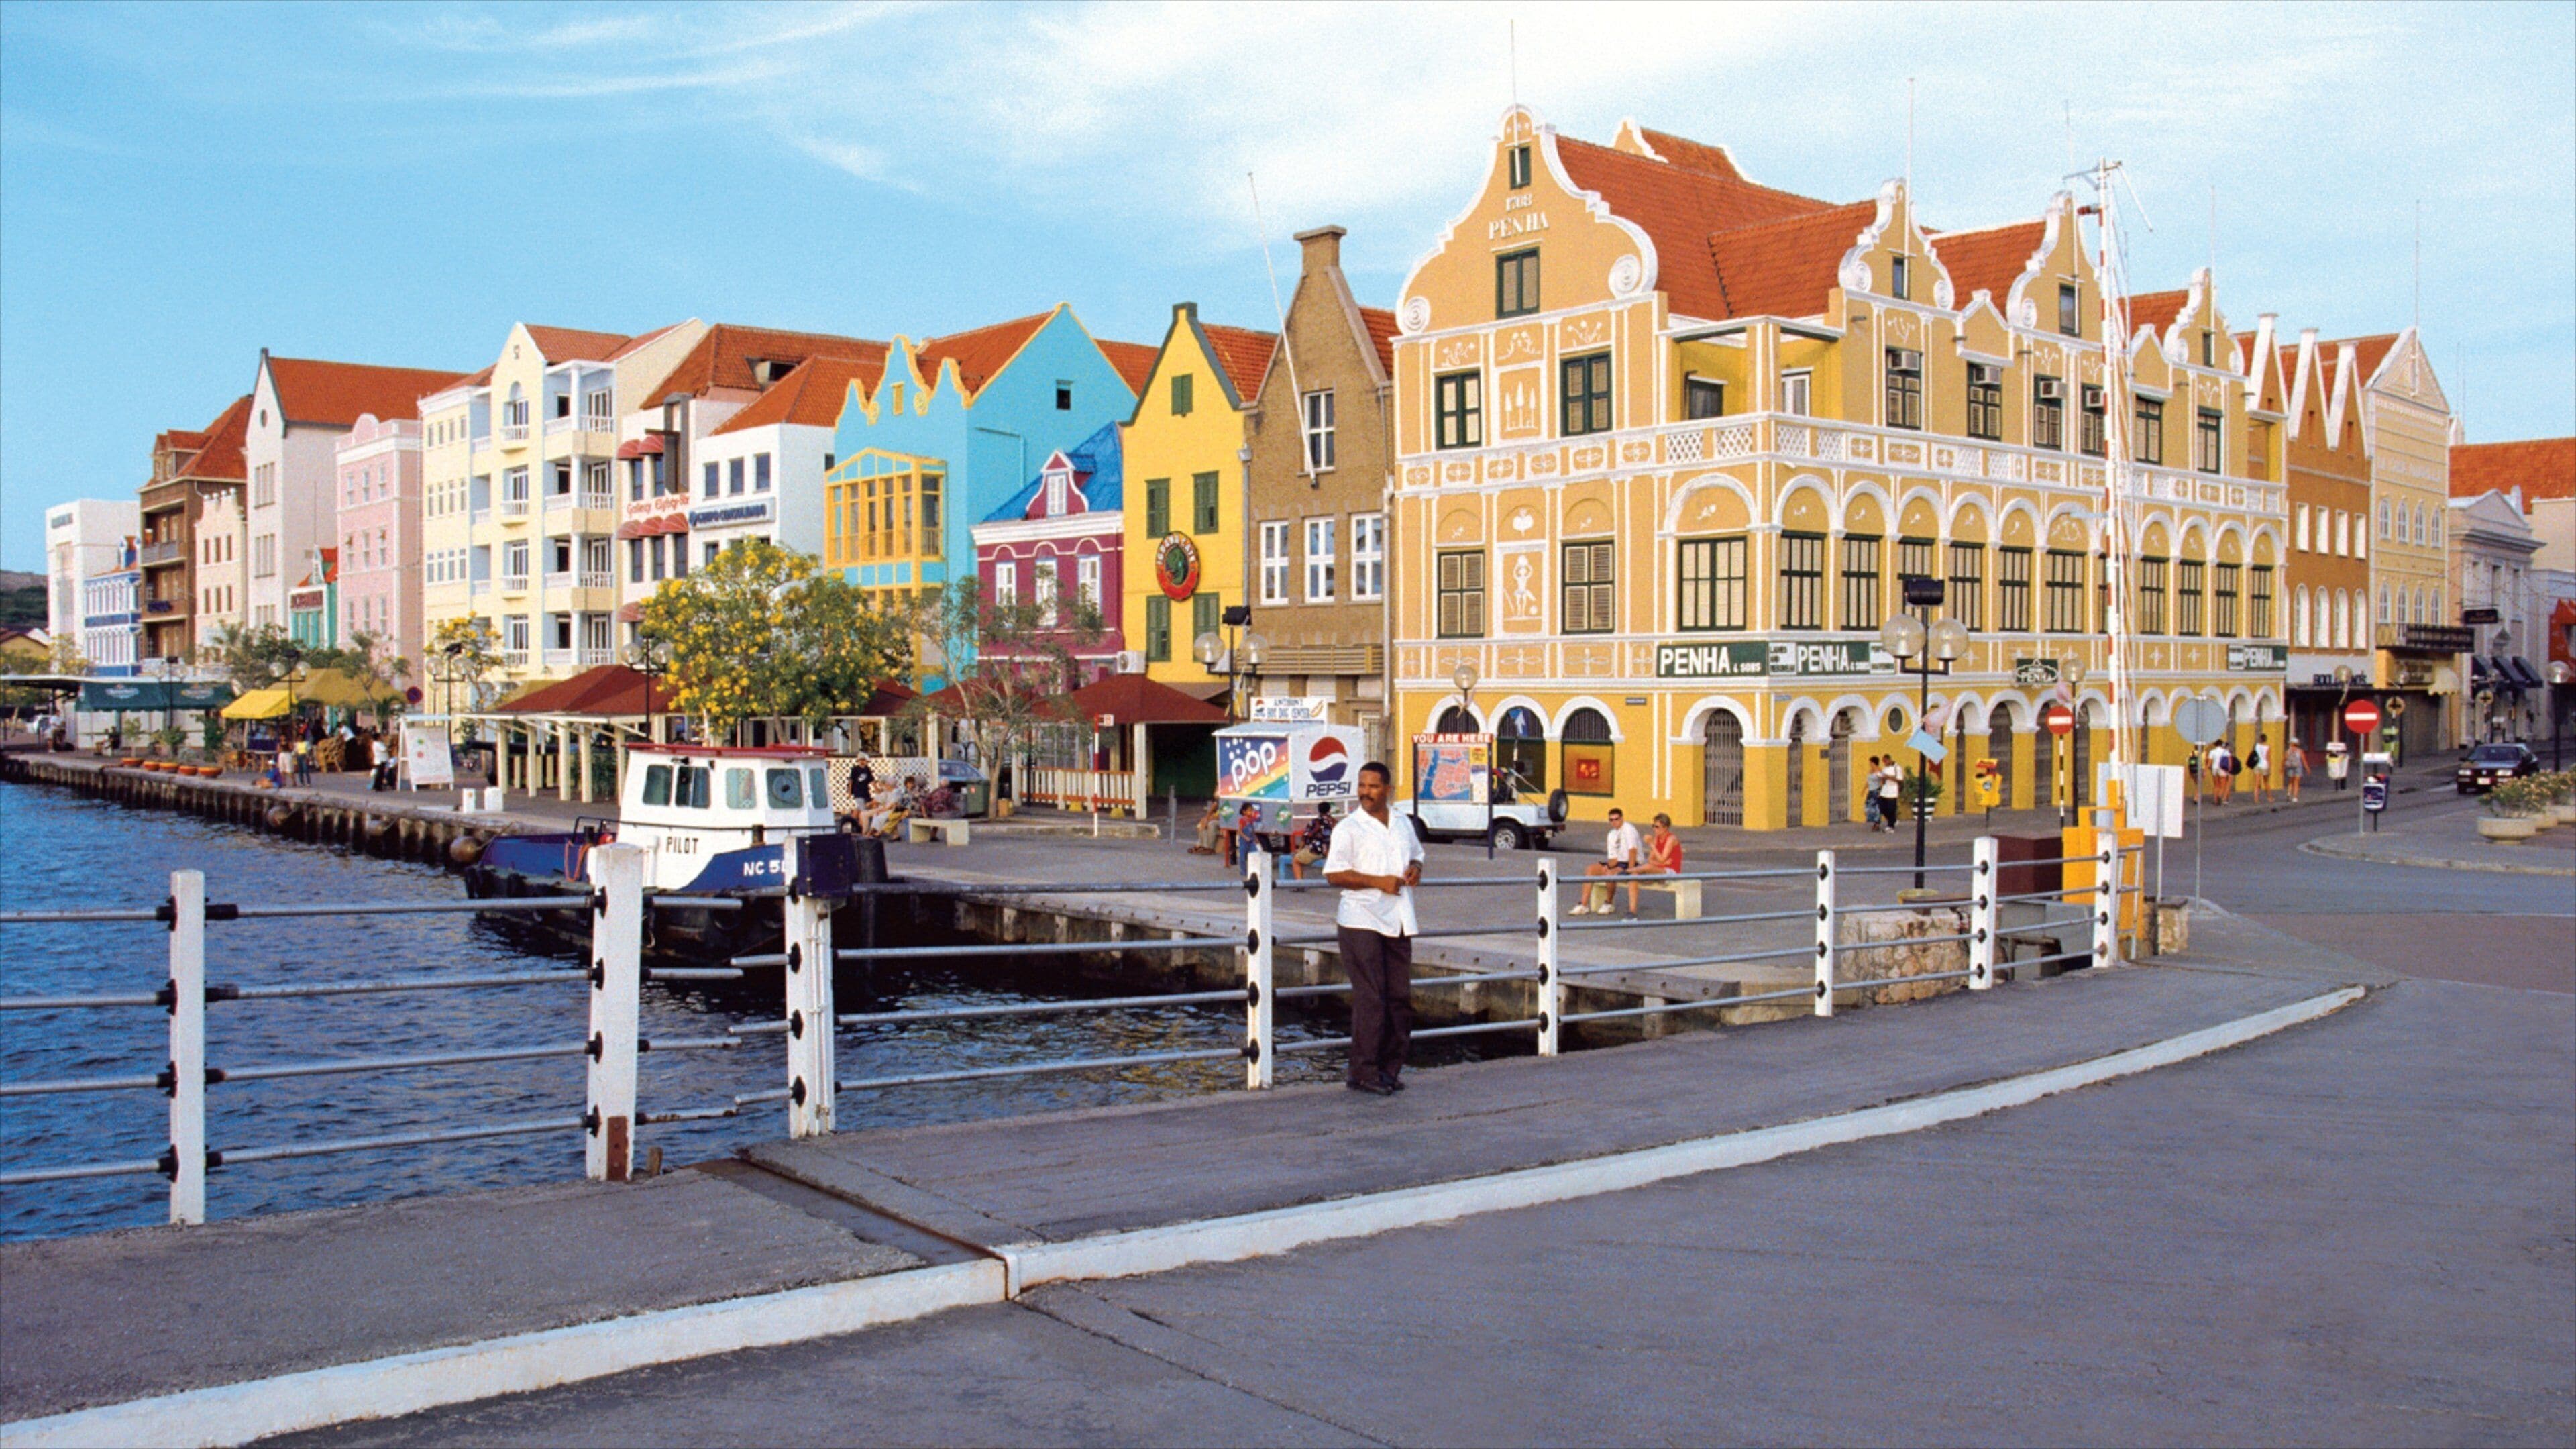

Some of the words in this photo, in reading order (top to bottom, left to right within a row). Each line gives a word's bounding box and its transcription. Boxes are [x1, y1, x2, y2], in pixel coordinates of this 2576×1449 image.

[1488, 211, 1549, 239] PENHA
[1660, 646, 1731, 674] PENHA
[1798, 645, 1849, 672] PENHA
[2243, 648, 2273, 668] PENHA
[1413, 734, 1434, 743] YOU
[1437, 734, 1459, 743] ARE
[1462, 734, 1491, 743] HERE
[1305, 782, 1351, 798] PEPSI
[666, 837, 698, 854] PILOT
[743, 861, 765, 877] NC
